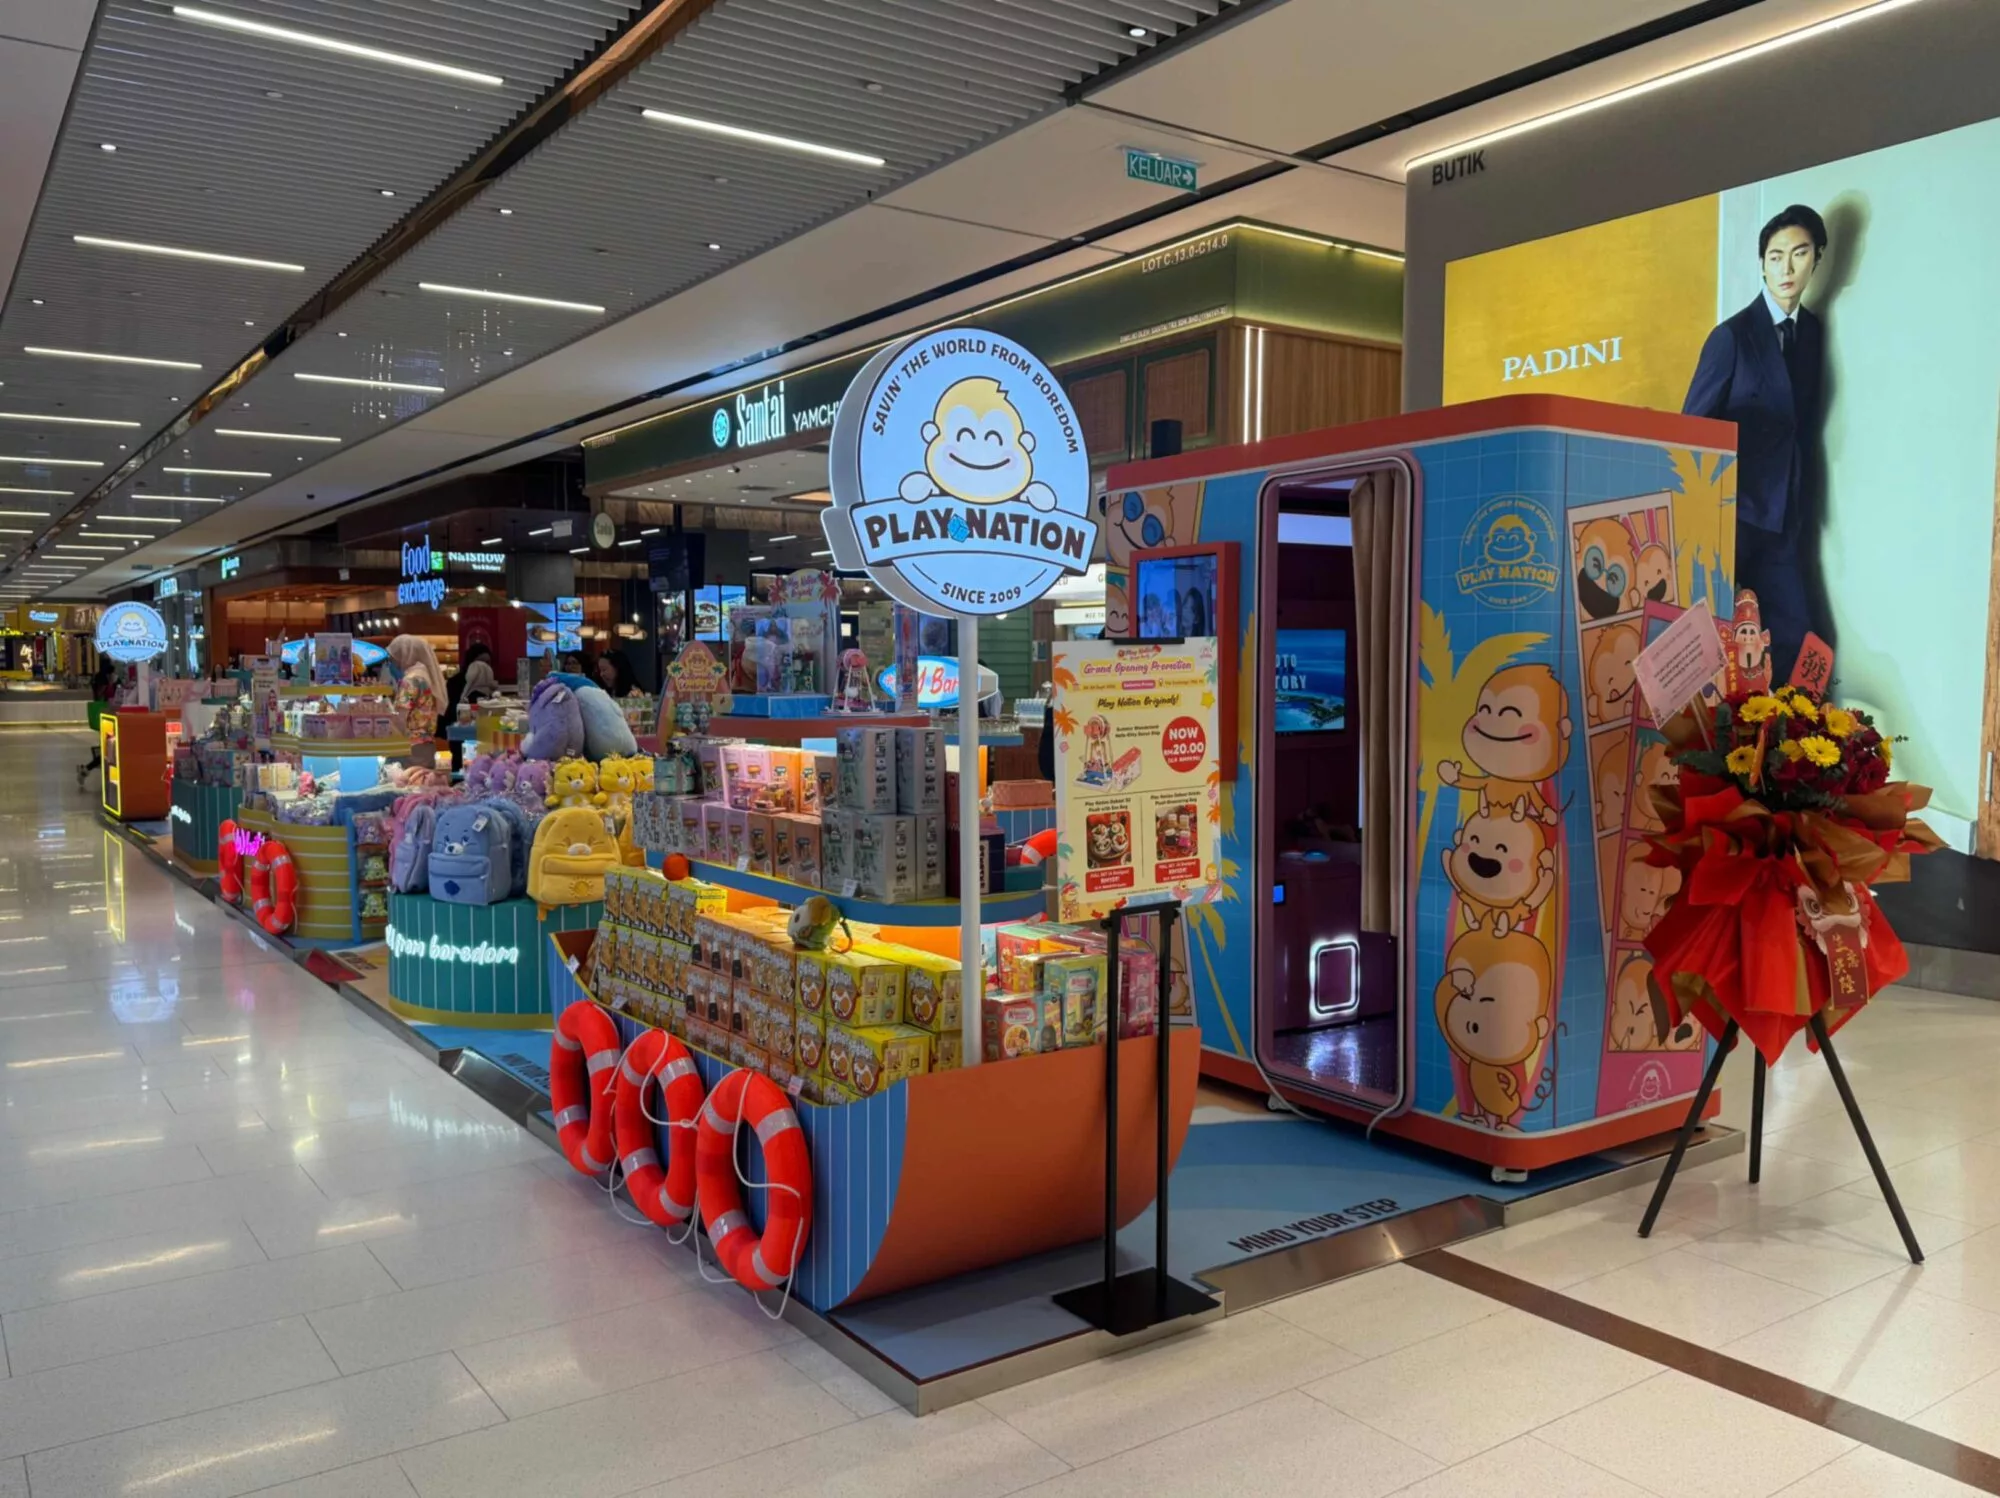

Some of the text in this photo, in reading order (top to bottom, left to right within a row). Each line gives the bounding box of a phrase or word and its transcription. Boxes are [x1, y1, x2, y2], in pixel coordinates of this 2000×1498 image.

[1129, 154, 1181, 186] KELUAR
[1431, 149, 1486, 187] BUTIK
[1141, 254, 1163, 273] LOT
[1501, 336, 1624, 382] PADINI
[872, 338, 1079, 455] SAVIN' THE WORLD FROM BOREDOM
[735, 379, 787, 448] Santai
[863, 508, 1086, 561] PLAY NATION
[401, 534, 430, 577] food
[397, 575, 446, 611] exchange
[1461, 566, 1556, 588] PLAY NATION
[940, 582, 1022, 605] SINCE 2009
[100, 640, 165, 650] PLAY NATION
[1083, 659, 1192, 676] Grand Opening Promotion
[1097, 693, 1179, 711] Play Nation Originals!
[1168, 726, 1199, 741] NOW
[428, 934, 520, 966] boredom
[1227, 1198, 1402, 1253] MIND YOUR STEP
